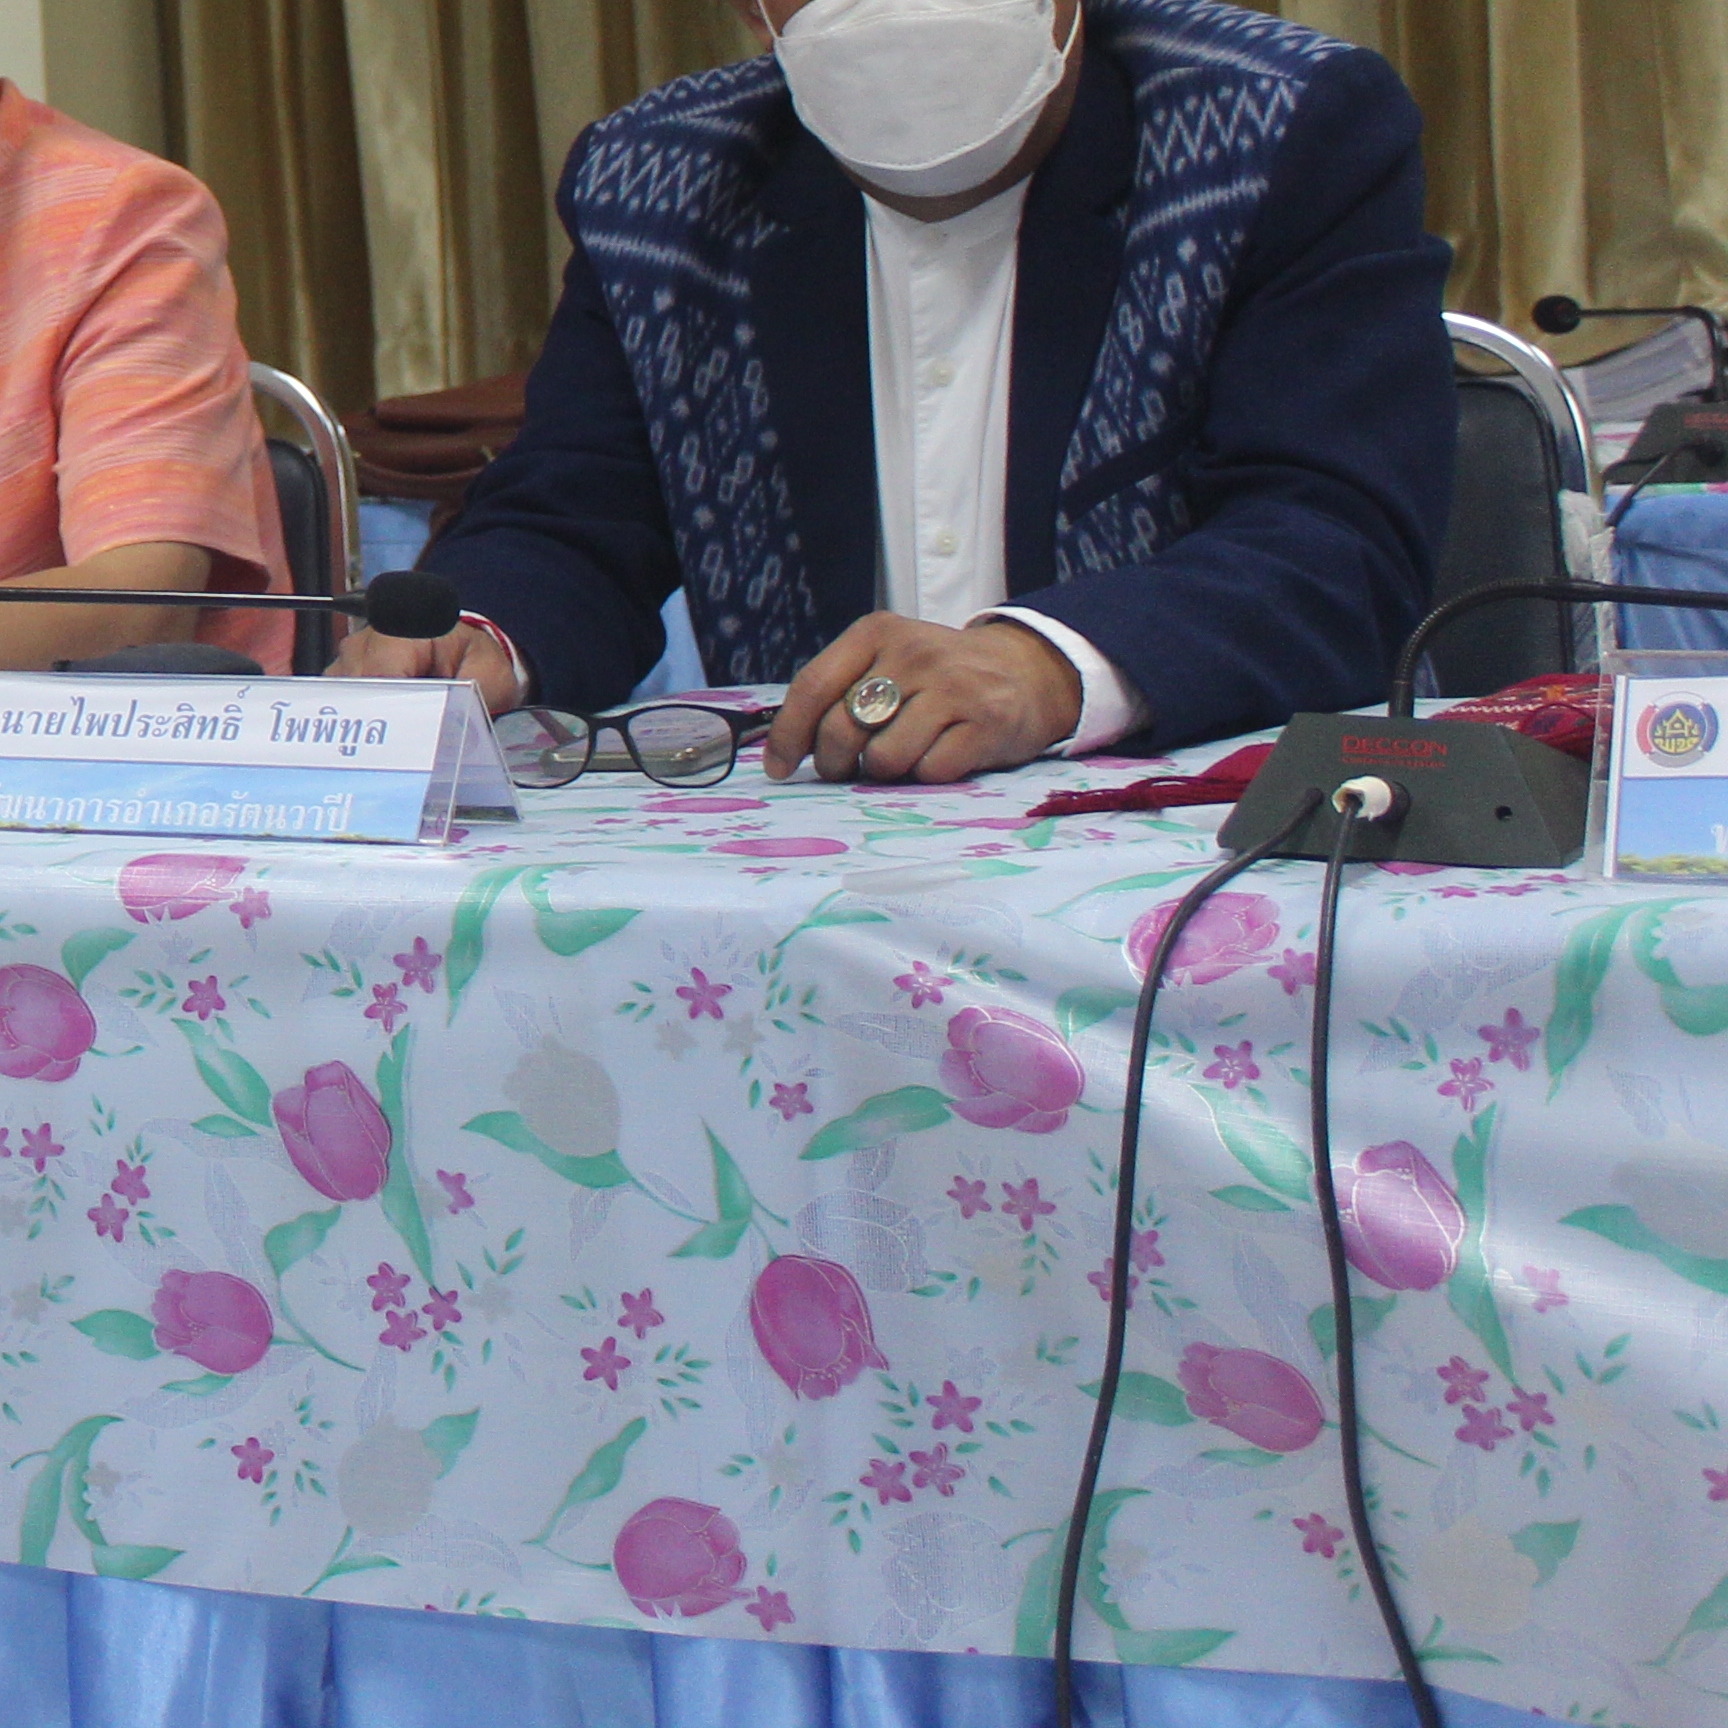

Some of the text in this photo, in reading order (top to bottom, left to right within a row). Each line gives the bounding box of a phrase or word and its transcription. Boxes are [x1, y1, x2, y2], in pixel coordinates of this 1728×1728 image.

[0, 686, 388, 757] นายไพประสิทธิ์ โพพิทูล
